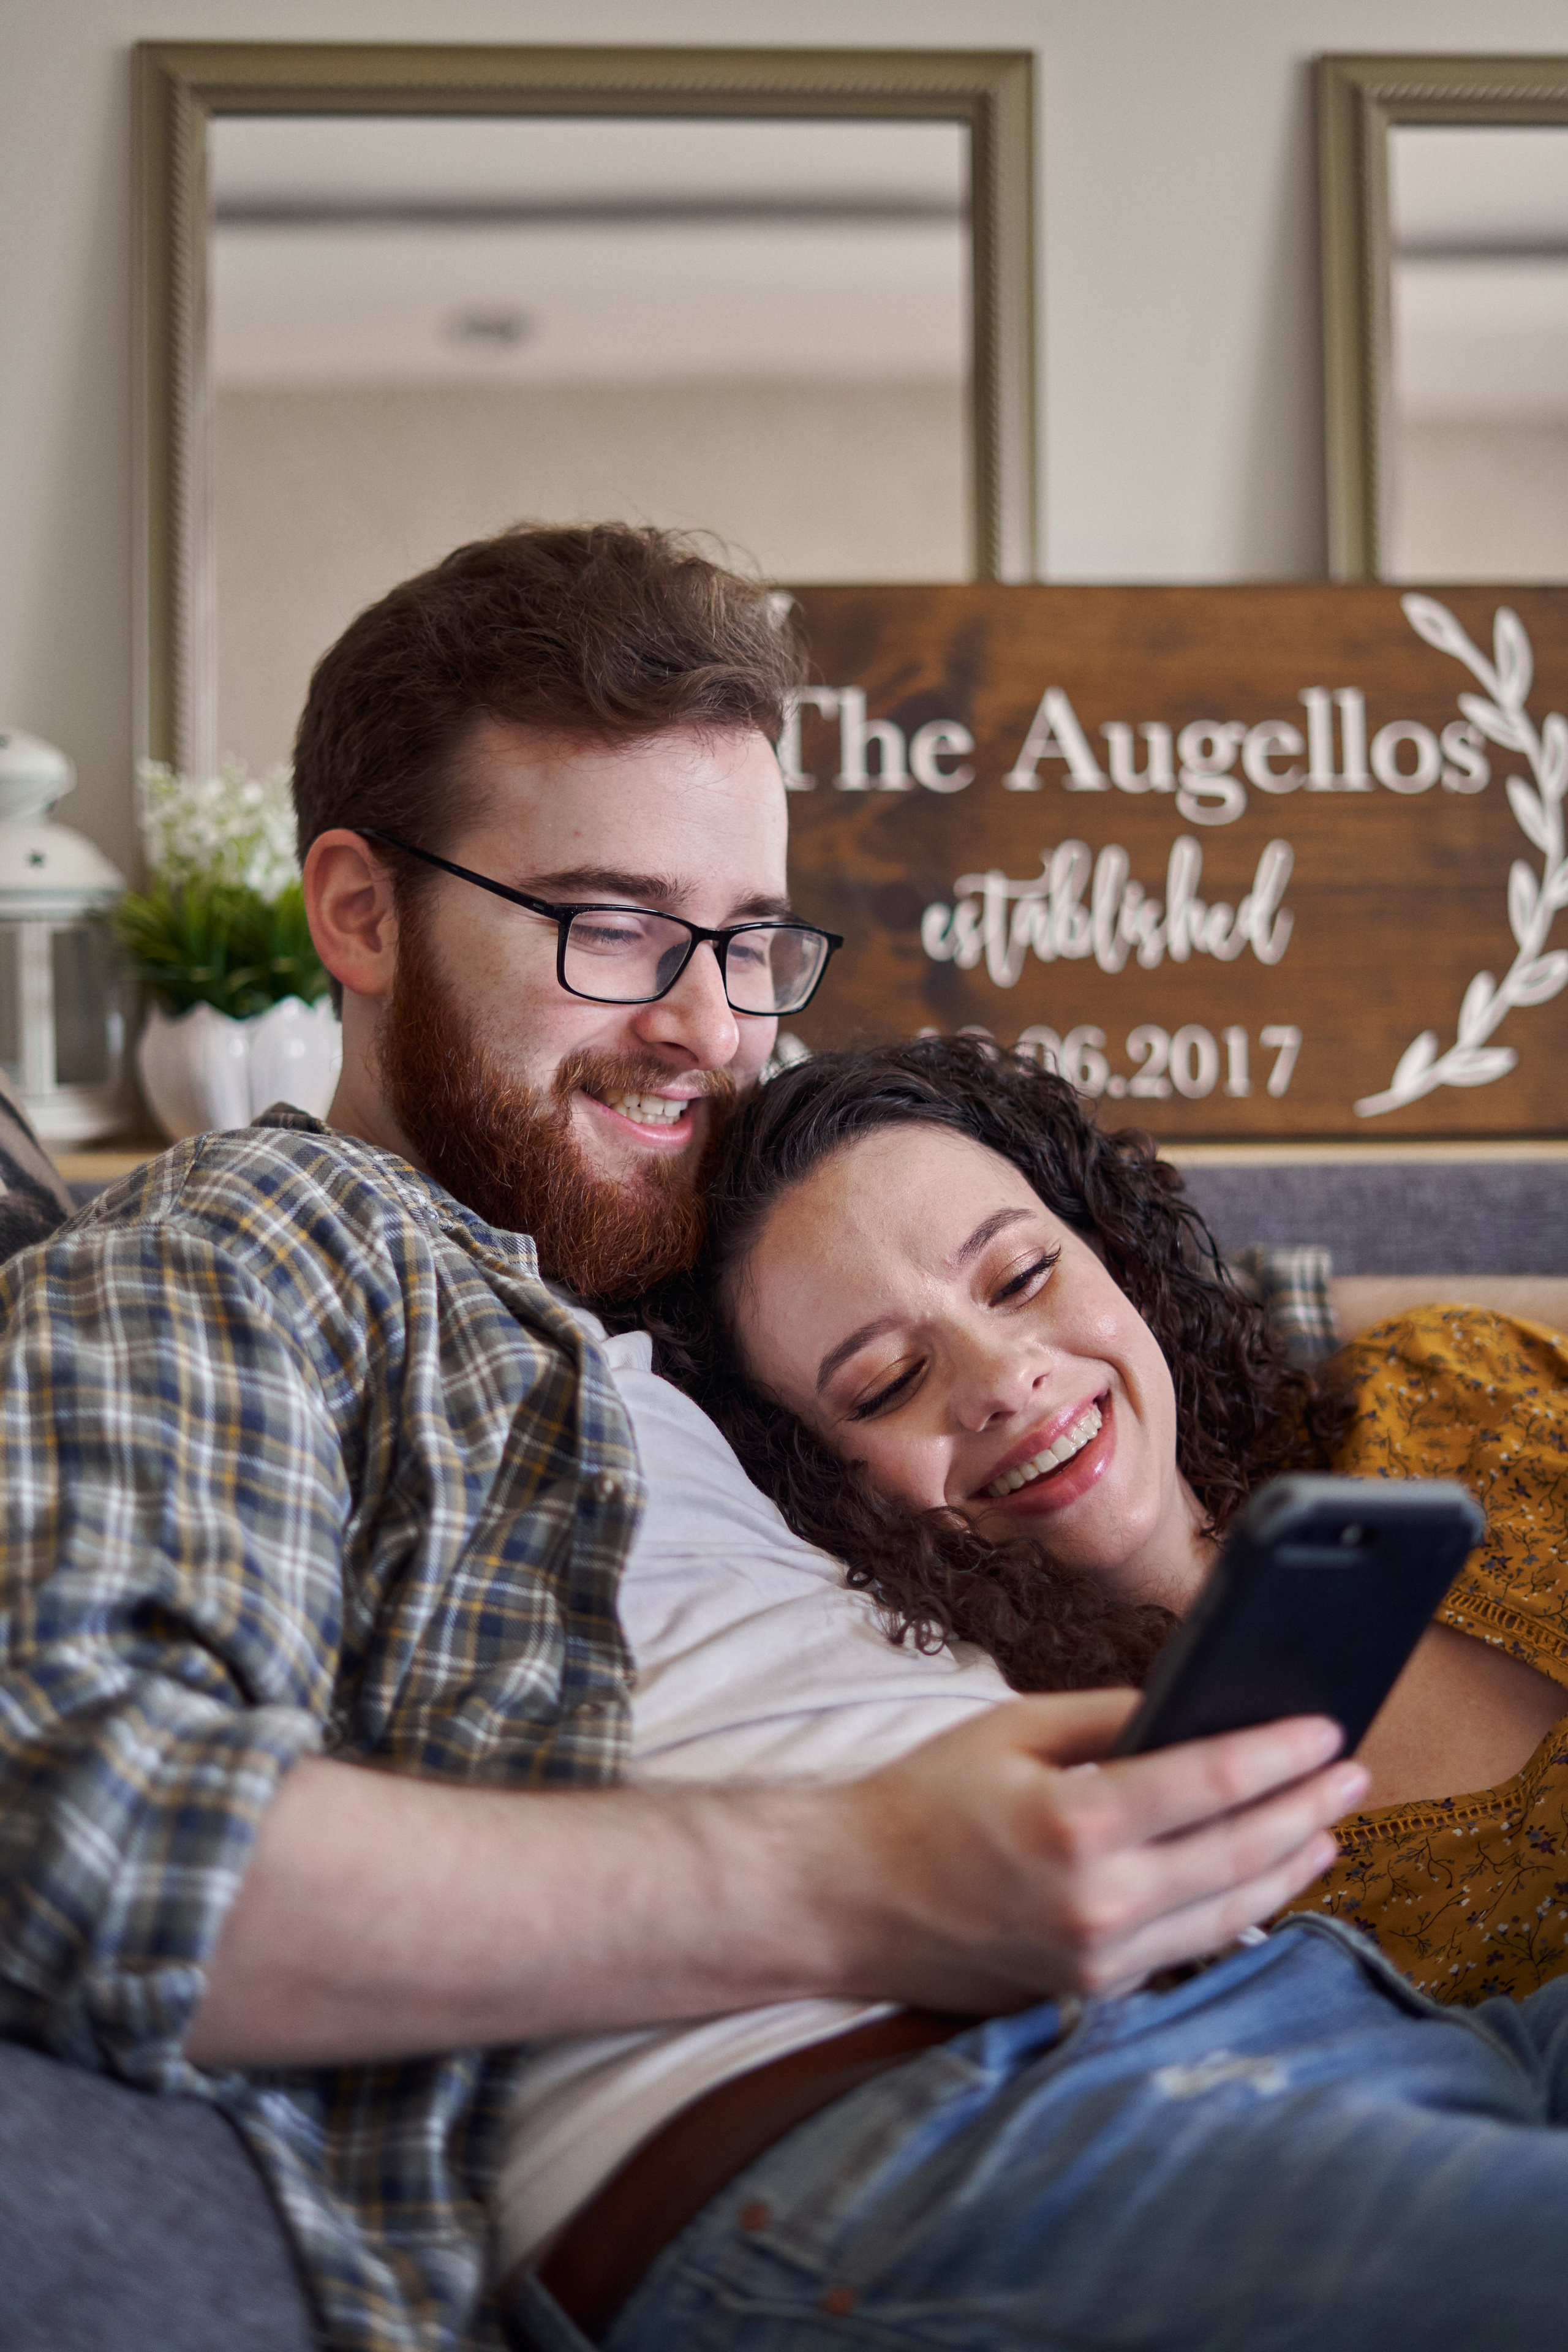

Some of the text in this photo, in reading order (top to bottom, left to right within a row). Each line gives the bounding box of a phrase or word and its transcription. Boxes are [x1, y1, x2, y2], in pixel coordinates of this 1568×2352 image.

[777, 684, 1491, 825] The Augellos
[921, 834, 1295, 988] established
[917, 1023, 1303, 1099] 06.2017
